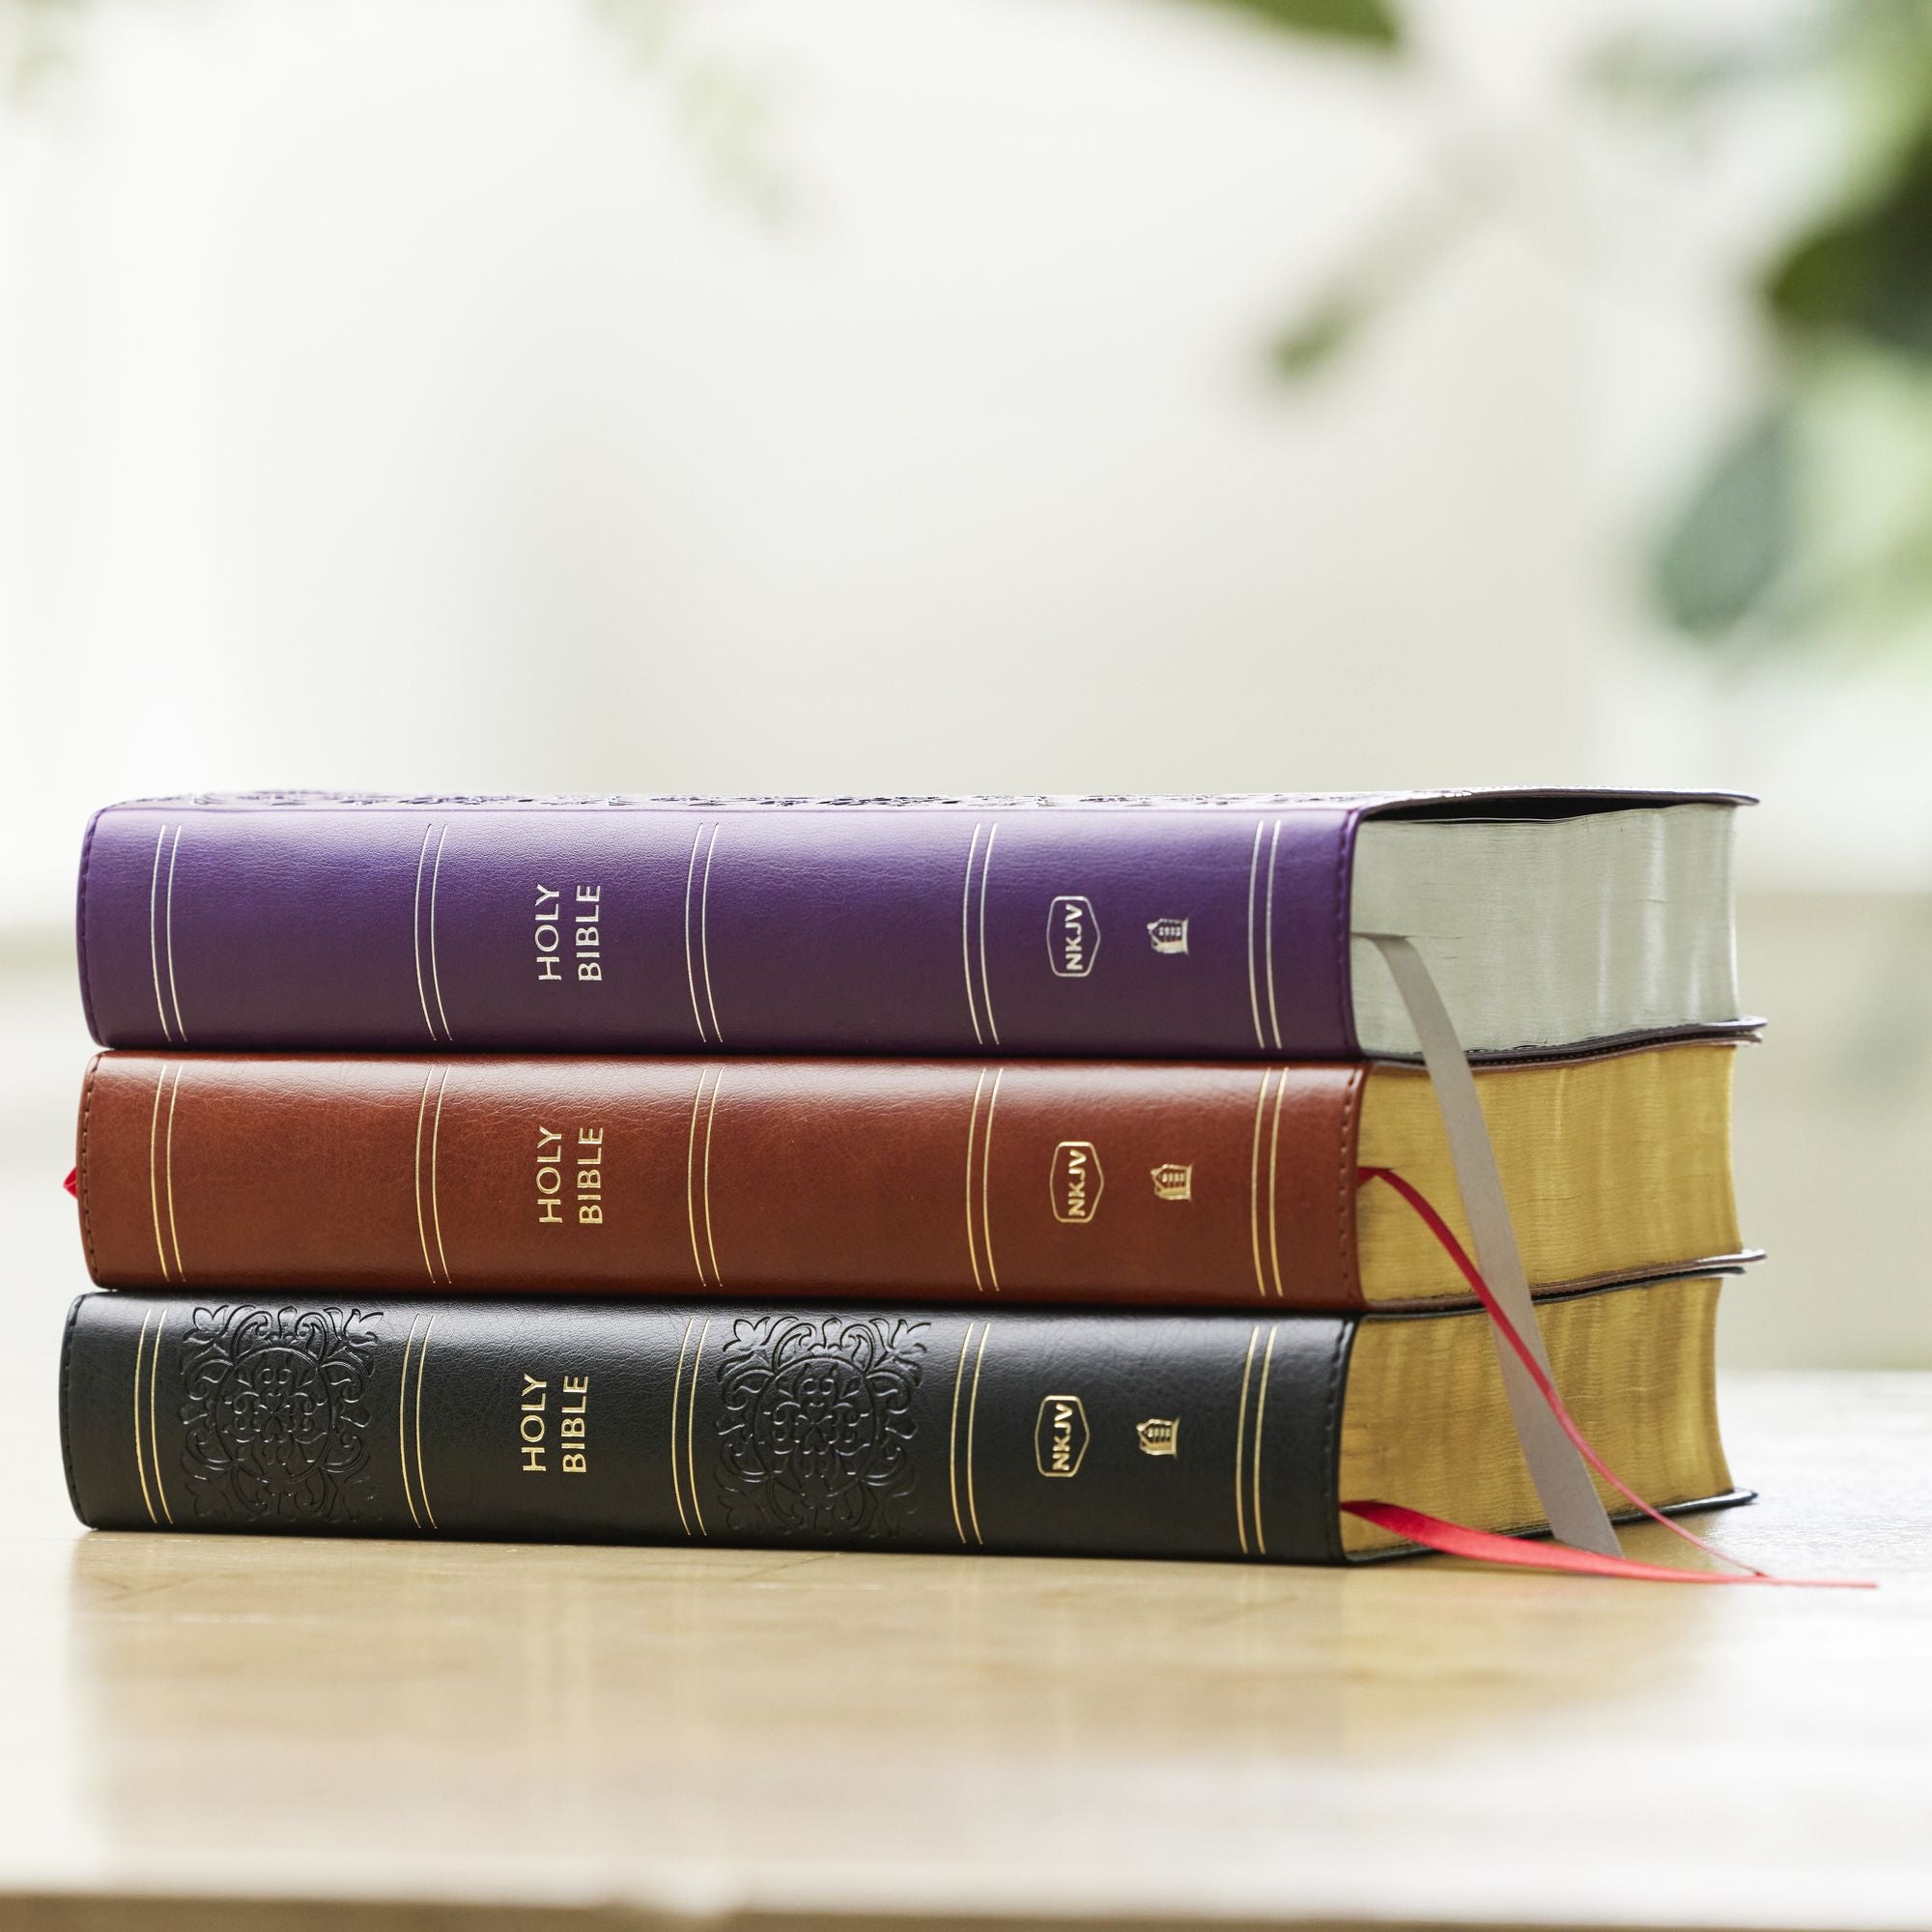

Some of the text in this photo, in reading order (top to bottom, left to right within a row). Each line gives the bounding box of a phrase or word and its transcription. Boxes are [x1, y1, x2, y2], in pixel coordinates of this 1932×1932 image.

[534, 883, 561, 980] HOLY
[575, 885, 602, 981] BIBLE
[1065, 903, 1083, 971] NKJV
[536, 1126, 562, 1223] HOLY
[577, 1127, 603, 1224] BIBLE
[1067, 1150, 1087, 1217] NKJV
[520, 1373, 547, 1472] HOLY
[560, 1376, 588, 1473] BIBLE
[1052, 1404, 1073, 1471] NKJV
